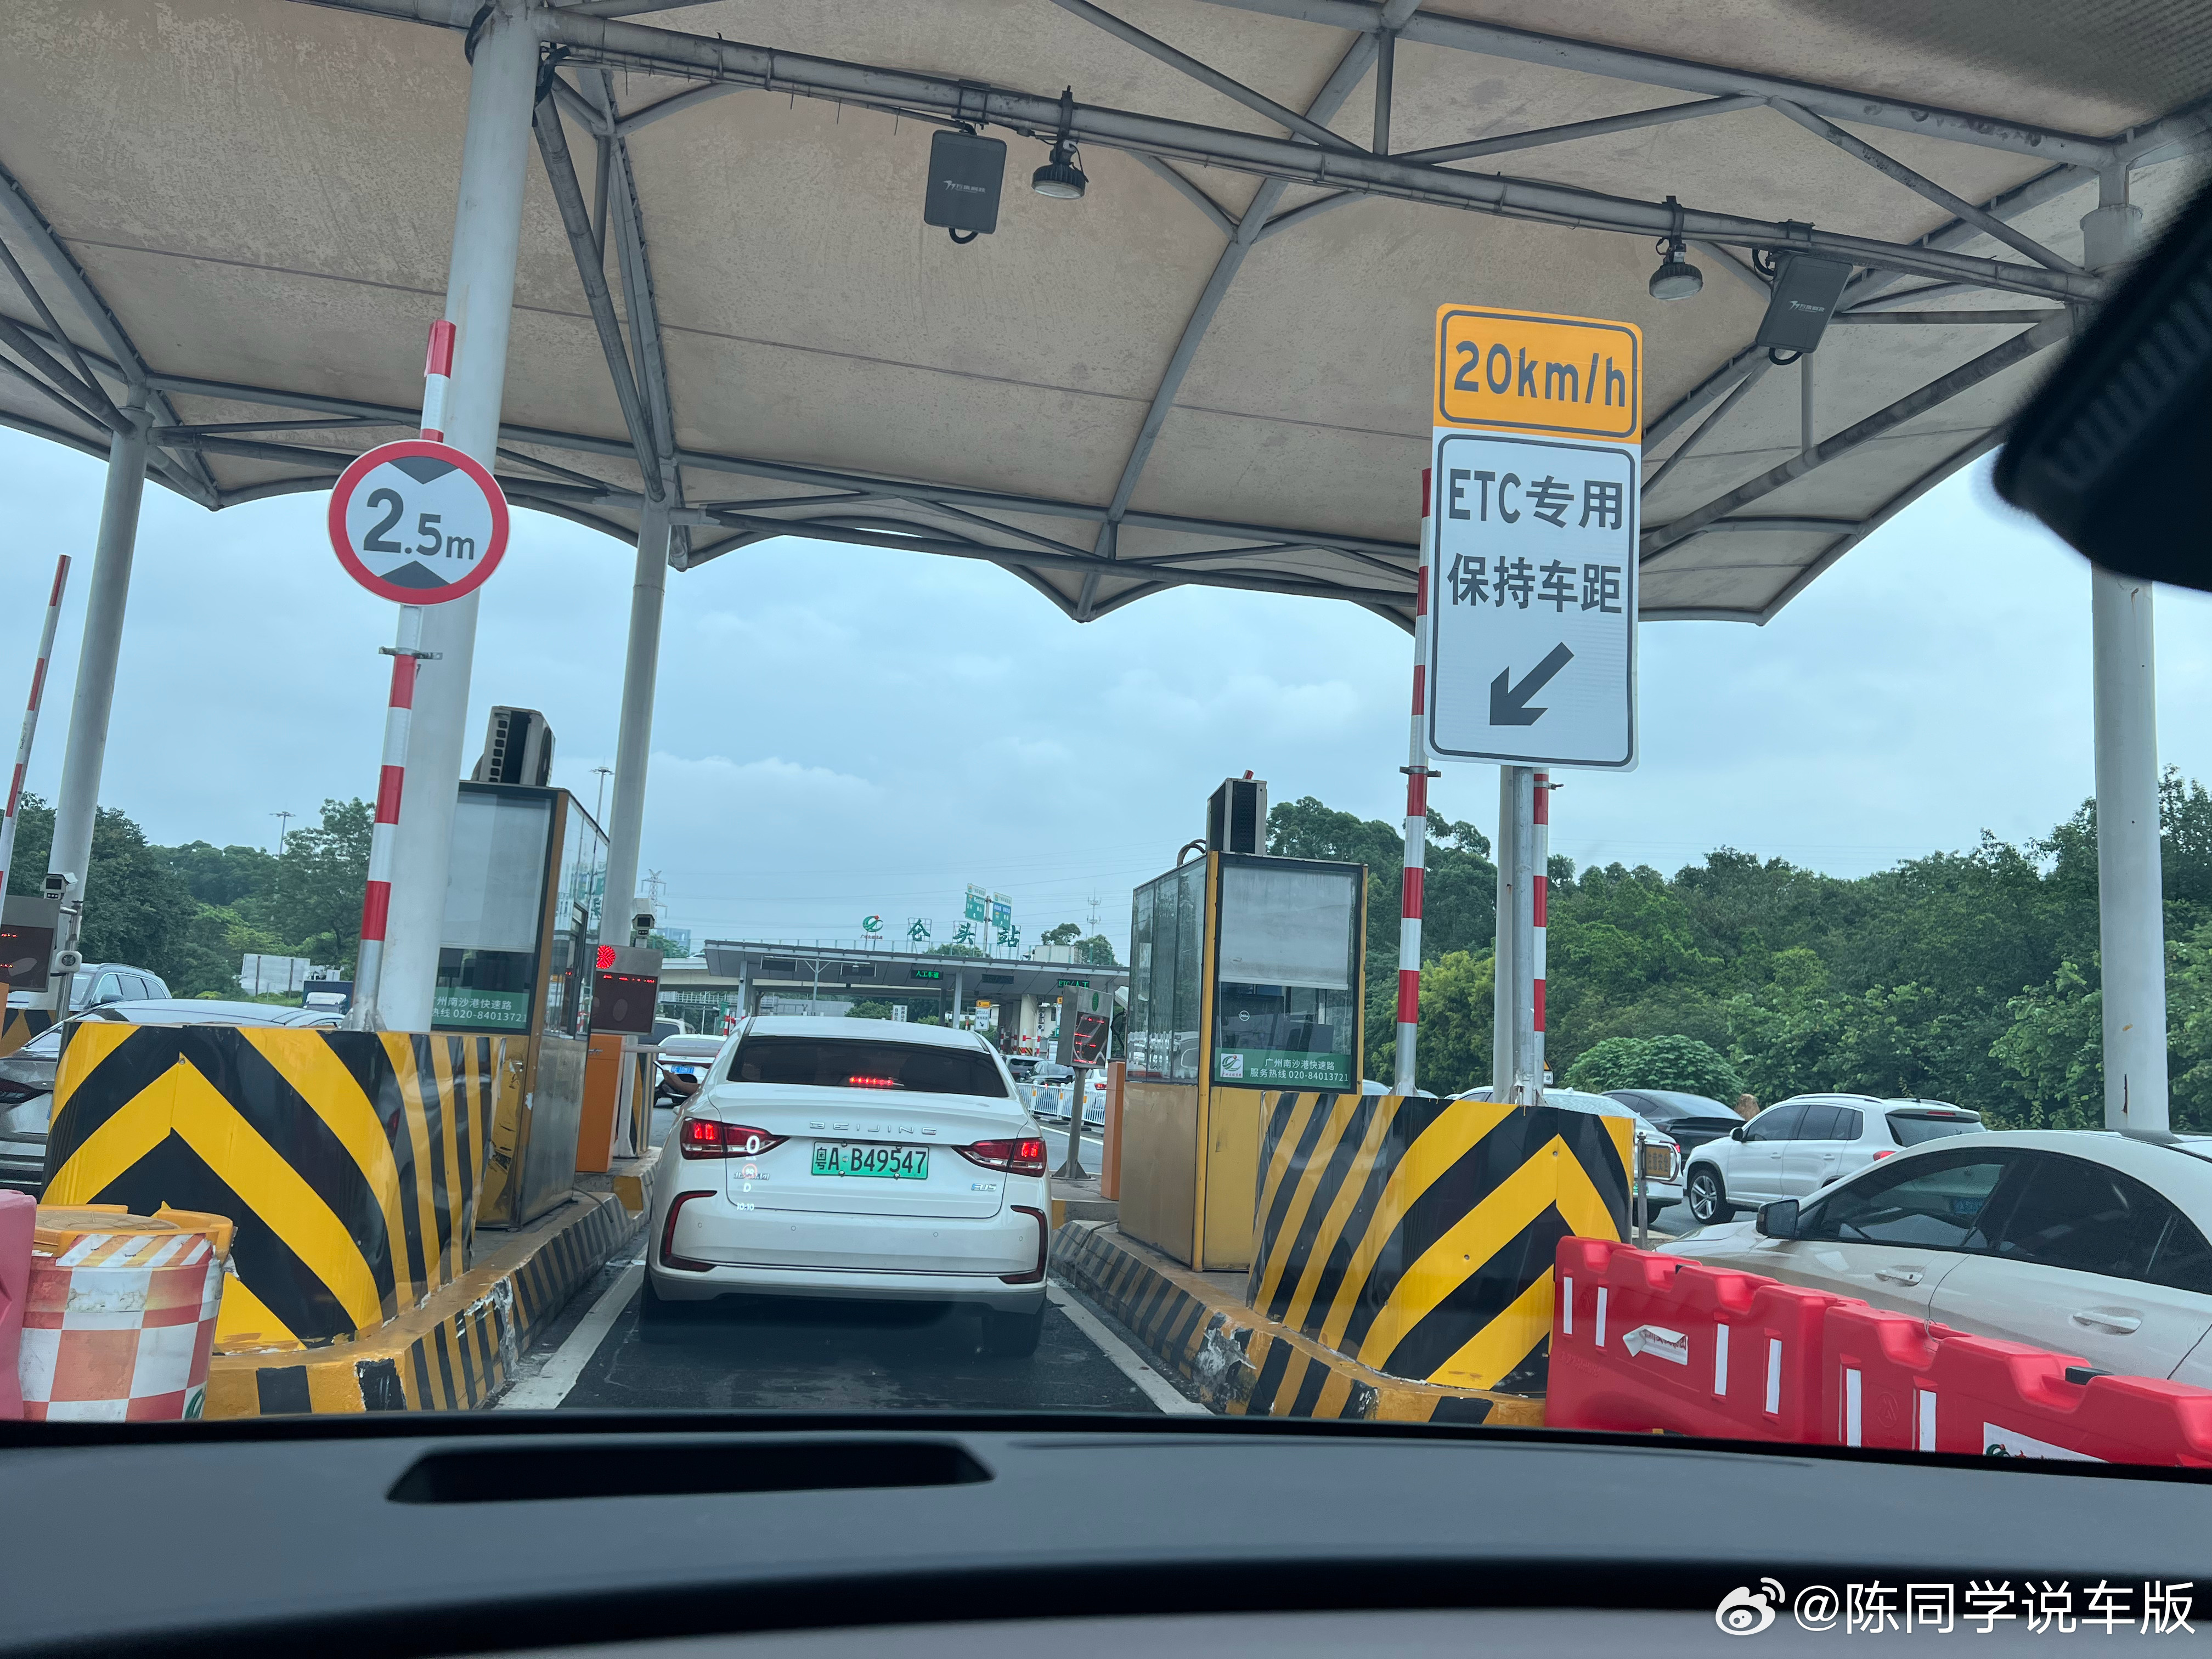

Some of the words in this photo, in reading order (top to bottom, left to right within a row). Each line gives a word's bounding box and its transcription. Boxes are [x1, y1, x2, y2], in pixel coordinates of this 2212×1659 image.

[1454, 341, 1626, 408] 20km/h
[1449, 468, 1623, 531] ETC专用
[363, 488, 475, 560] 2.5m
[1447, 552, 1623, 613] 保持车距
[907, 918, 1020, 947] 仓头站
[434, 996, 512, 1010] 州南沙港快速路
[453, 1009, 527, 1023] 020-84013721
[1265, 1058, 1335, 1070] 广州南沙港快速路
[1250, 1068, 1286, 1079] 服务热线
[1289, 1070, 1348, 1082] 020-84013721
[810, 1121, 936, 1135] BEIJING
[746, 1135, 760, 1154] 0
[743, 1183, 752, 1192] D
